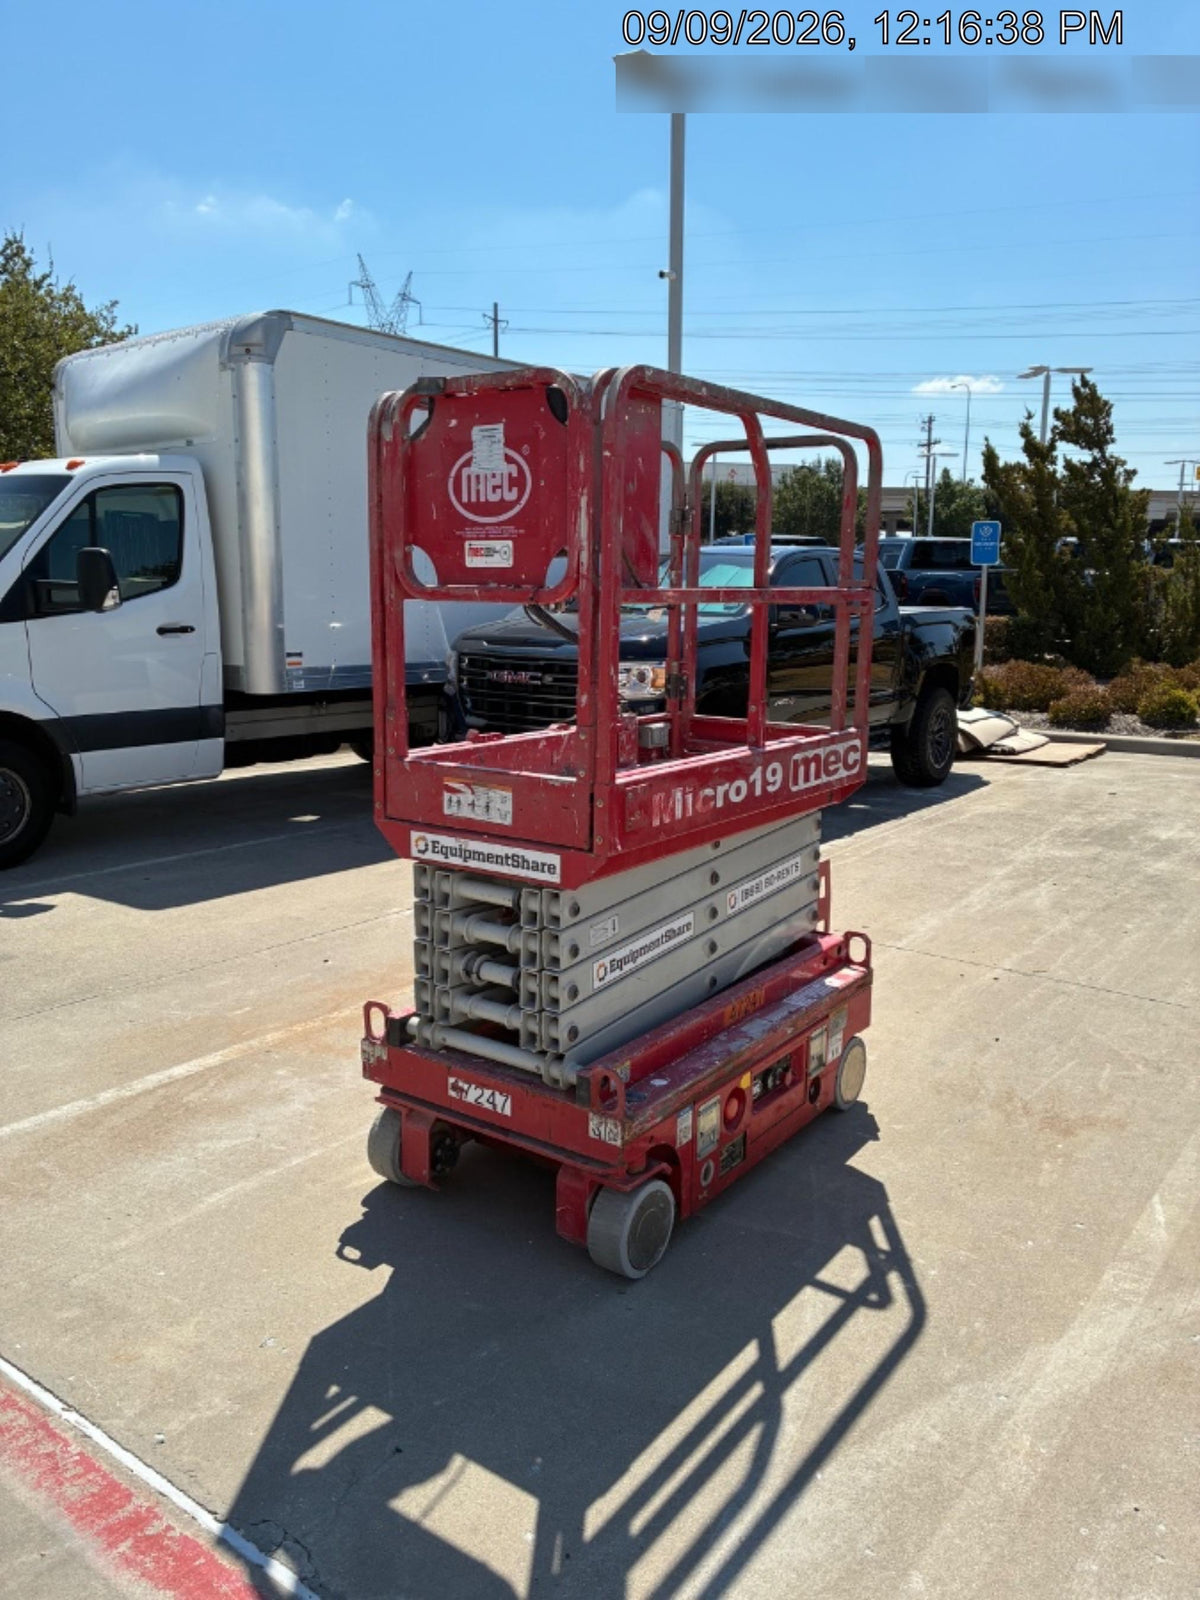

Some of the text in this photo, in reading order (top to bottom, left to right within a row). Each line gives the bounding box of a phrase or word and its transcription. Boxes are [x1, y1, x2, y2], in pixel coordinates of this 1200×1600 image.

[651, 762, 783, 827] Micro19
[430, 840, 557, 875] EquipmentShare
[609, 921, 693, 972] EquipmentShare
